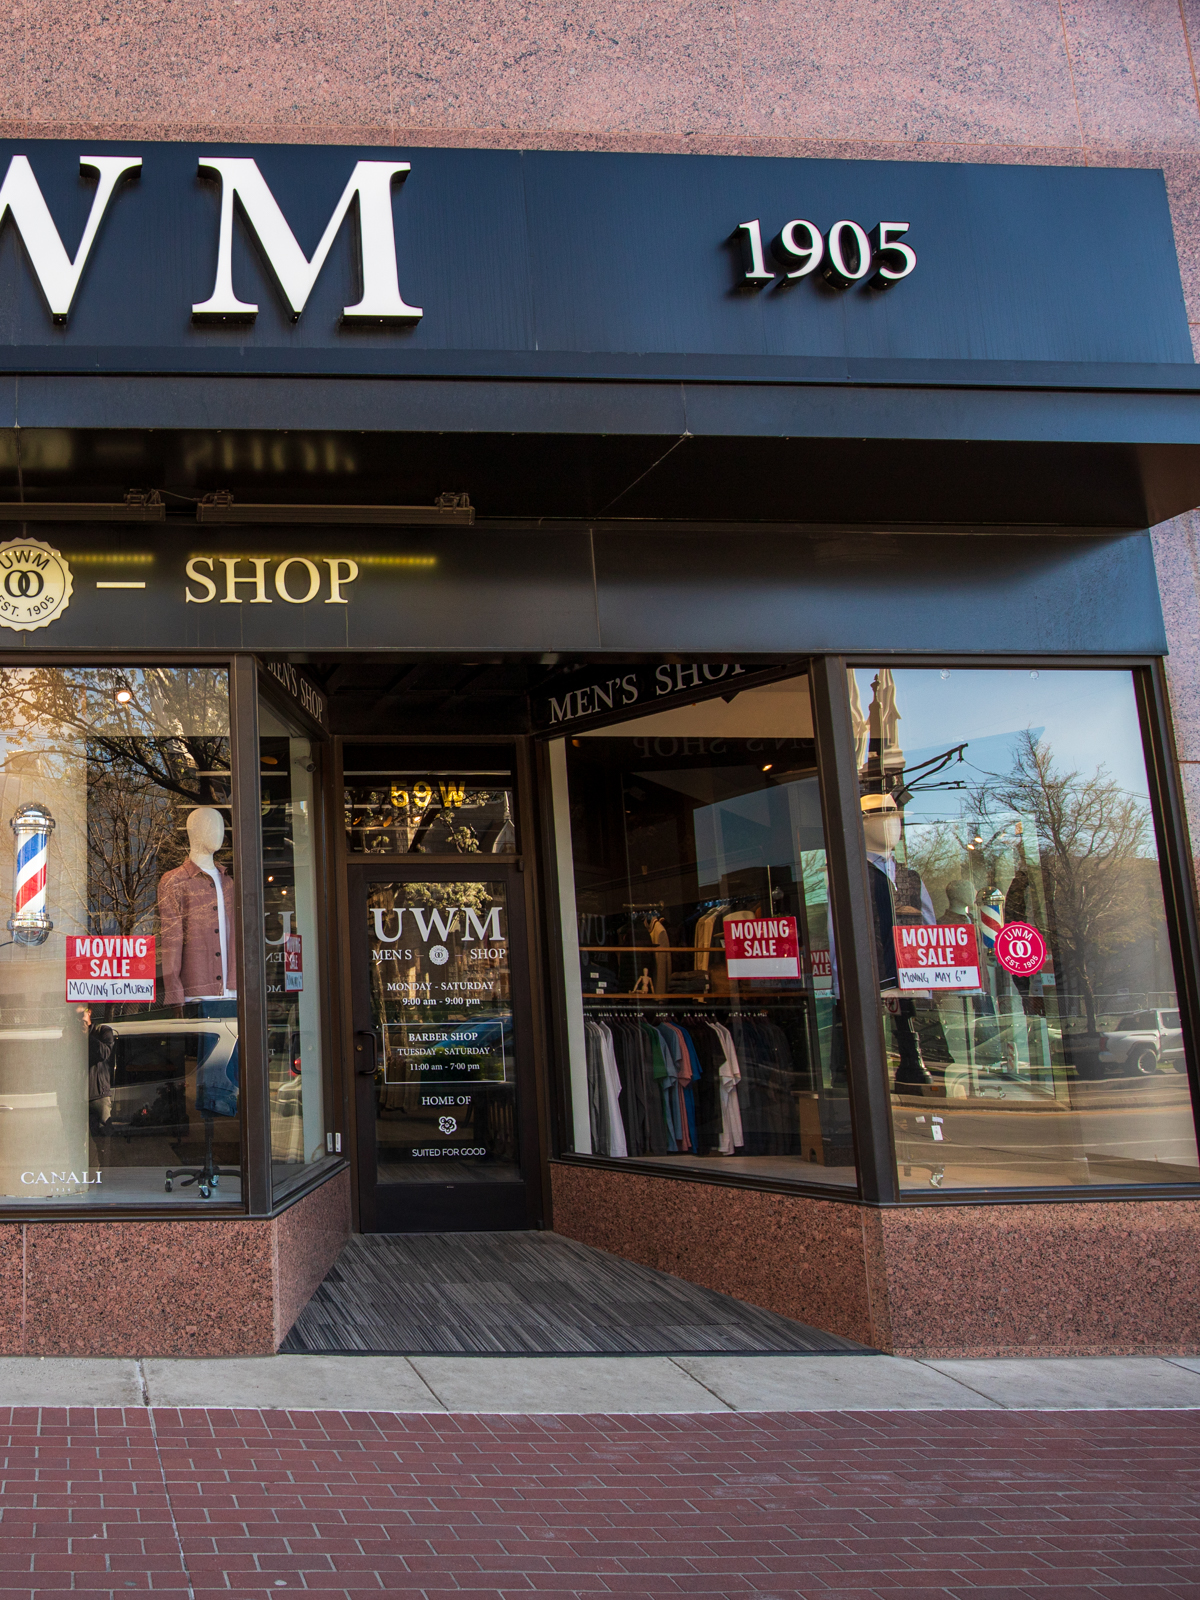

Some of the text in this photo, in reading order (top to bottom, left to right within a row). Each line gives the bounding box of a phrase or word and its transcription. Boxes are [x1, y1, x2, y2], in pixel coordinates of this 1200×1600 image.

[737, 217, 918, 280] 1905
[185, 557, 360, 604] SHOP
[26, 594, 55, 617] 1905
[300, 677, 323, 724] SHOP
[548, 674, 638, 725] MEN'S
[390, 781, 433, 808] 59
[369, 907, 506, 942] UWM
[730, 920, 790, 940] MOVING
[902, 927, 968, 947] MOVING
[1004, 928, 1033, 942] UWM
[75, 938, 148, 958] MOVING
[470, 948, 506, 960] SHOP
[743, 940, 777, 957] SALE
[917, 948, 955, 966] SALE
[1004, 955, 1039, 970] EST. 1905
[90, 959, 131, 977] SALE
[901, 971, 930, 983] MOVING
[934, 971, 951, 983] MAY
[69, 981, 109, 997] MOVING
[123, 982, 154, 997] MURRAY
[387, 982, 432, 991] MONDAY
[440, 981, 494, 990] SATURDAY
[402, 997, 421, 1006] 9:00
[445, 997, 464, 1005] 9:00
[466, 998, 481, 1007] pm
[408, 1032, 478, 1042] BARBER SHOP
[398, 1048, 437, 1056] TUESDAY
[444, 1047, 490, 1055] SATURDAY
[410, 1063, 430, 1071] 11:00
[467, 1064, 480, 1072] pm
[421, 1095, 472, 1106] HOME OF
[411, 1147, 487, 1157] SUITED FOR GOOD
[20, 1171, 103, 1185] CANALI
